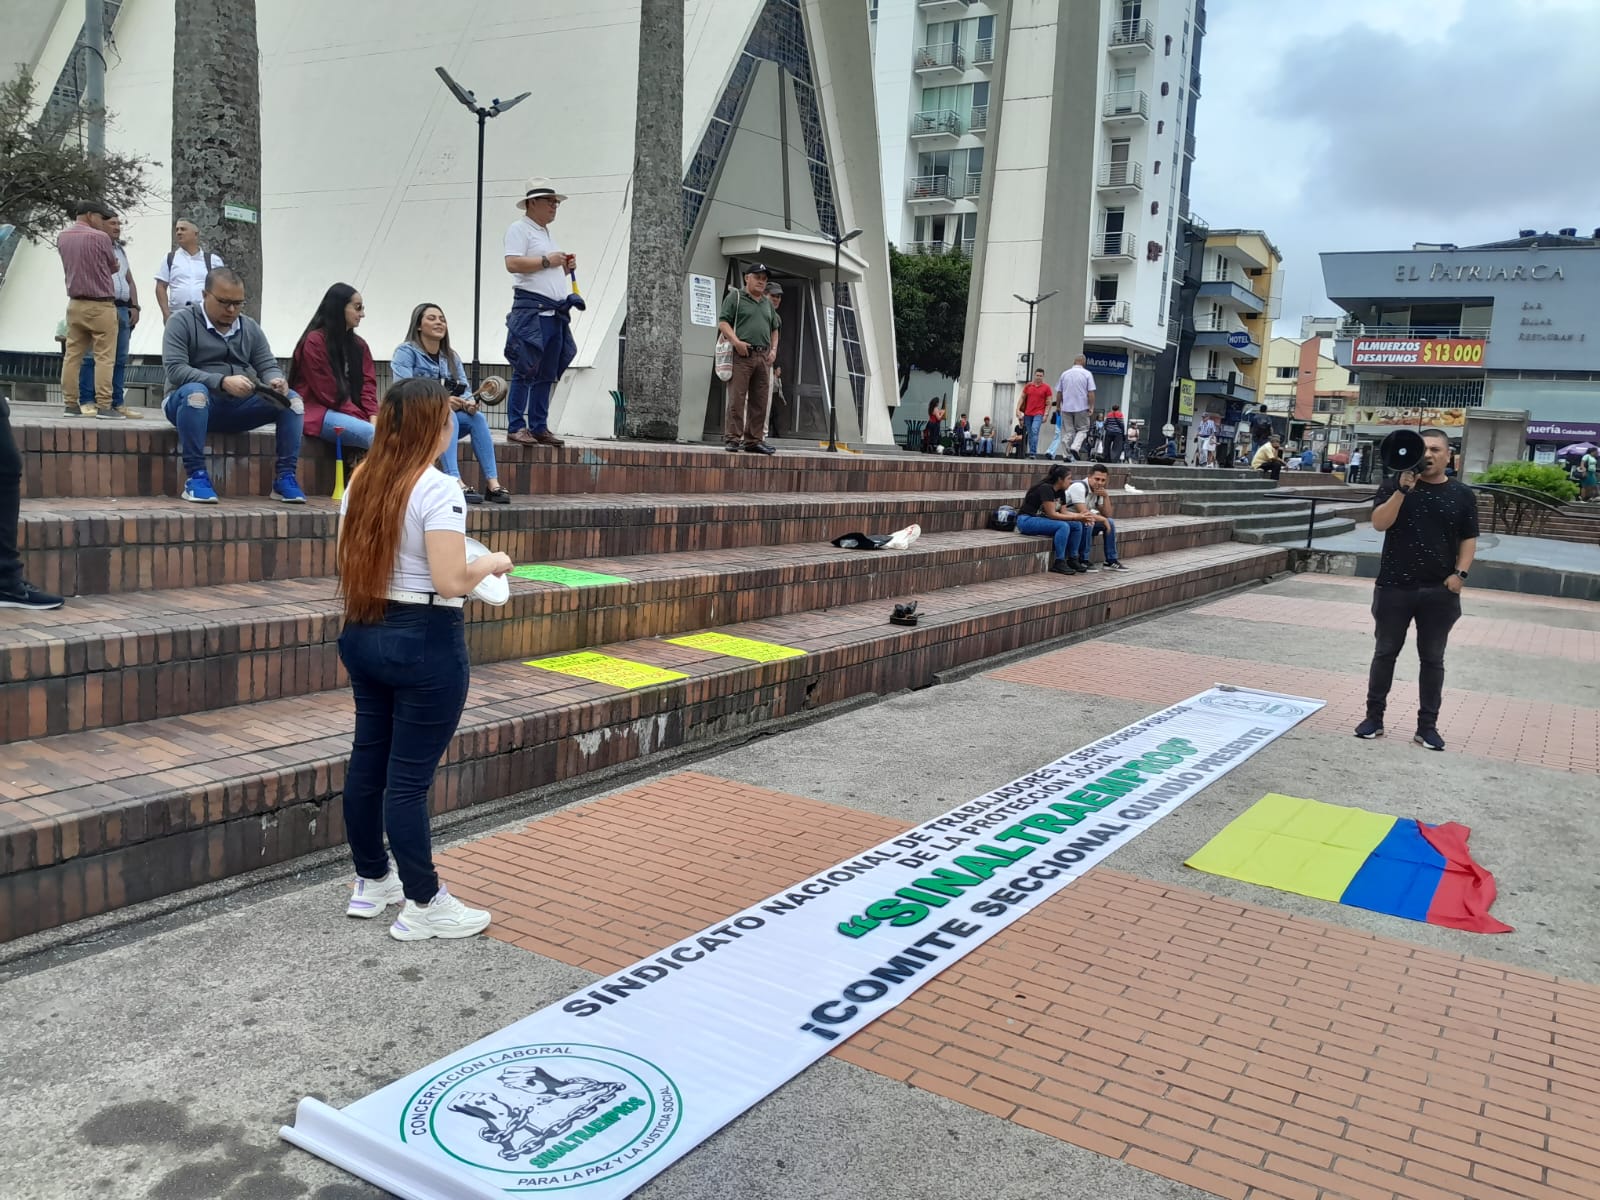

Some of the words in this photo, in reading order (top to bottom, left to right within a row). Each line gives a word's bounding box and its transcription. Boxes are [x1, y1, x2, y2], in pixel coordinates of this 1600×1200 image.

[1395, 265, 1419, 281] EL
[1429, 263, 1565, 282] PATRIARCA
[1086, 358, 1108, 366] Mundo
[1109, 360, 1126, 369] Mujer
[1229, 335, 1248, 344] HOTEL
[1356, 354, 1417, 362] DESAYUNOS
[1357, 341, 1420, 351] ALMUERZOS
[896, 850, 940, 869] DE
[930, 835, 971, 851] LA
[959, 779, 1076, 836] PROTECCIÓN
[1065, 755, 1123, 779] SOCIAL
[562, 914, 766, 1018] SINDICATO
[760, 850, 901, 915] NACIONAL
[892, 832, 934, 849] DE
[923, 768, 1062, 832] TRABAJADORES
[1069, 726, 1148, 761] SERVIDORES
[800, 918, 983, 1041] ¡COMITE
[970, 823, 1131, 917] SECCIONAL
[1118, 772, 1204, 820] QUINDÍO
[1191, 727, 1275, 773] PRESENTE!
[410, 1059, 487, 1136] CONCERTACIÓN
[489, 1046, 573, 1065] LABORAL
[517, 1176, 560, 1187] PARA
[563, 1171, 584, 1181] LA
[585, 1162, 613, 1177] PAZ
[614, 1156, 624, 1166] Y
[625, 1146, 642, 1160] LA
[643, 1113, 673, 1149] JUSTICIA
[659, 1085, 675, 1113] SOCIAL
[529, 1096, 647, 1169] SINALTRAEMPROS
